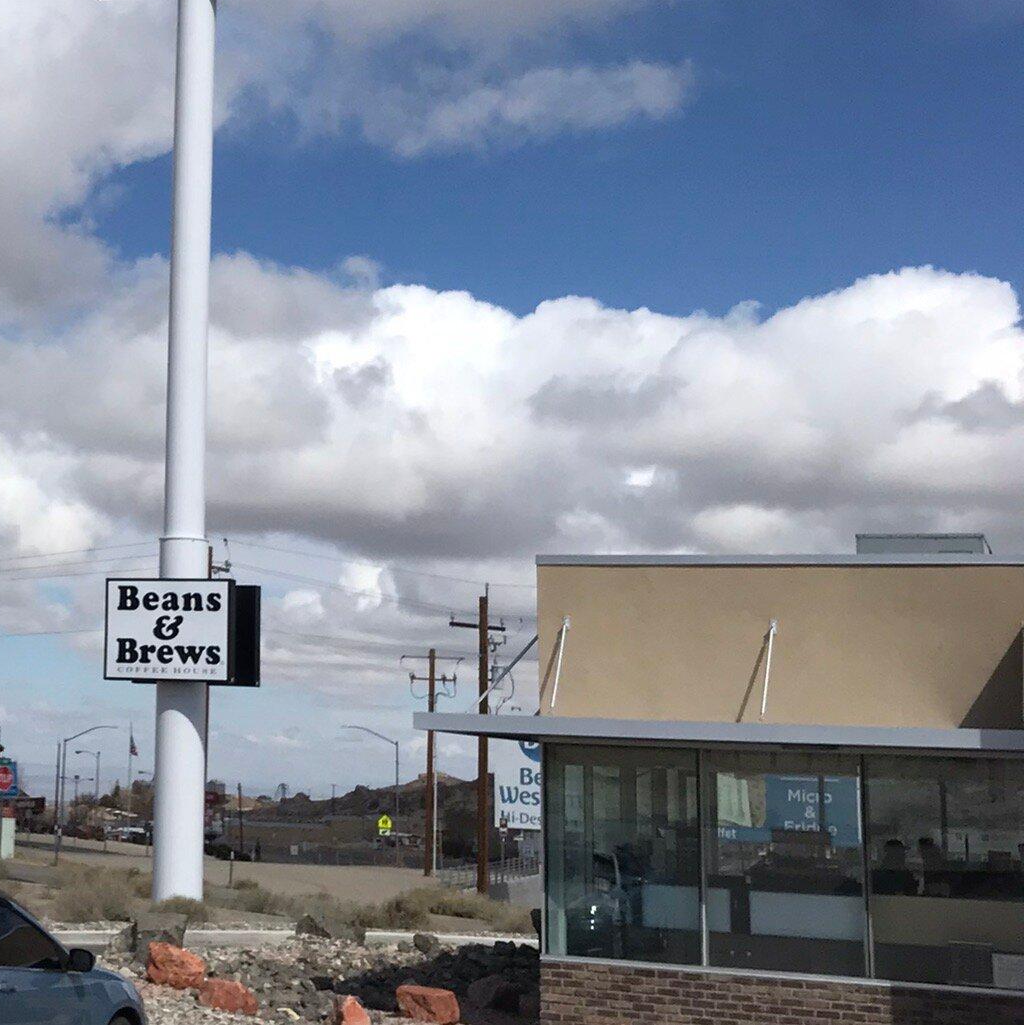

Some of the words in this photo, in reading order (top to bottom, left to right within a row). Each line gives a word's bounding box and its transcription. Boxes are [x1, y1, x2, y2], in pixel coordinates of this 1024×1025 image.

[117, 585, 222, 612] Beans
[153, 615, 184, 641] &
[116, 638, 221, 665] Brews
[116, 666, 168, 674] COFFEE
[173, 667, 217, 675] HOUSE
[499, 785, 541, 806] Wes
